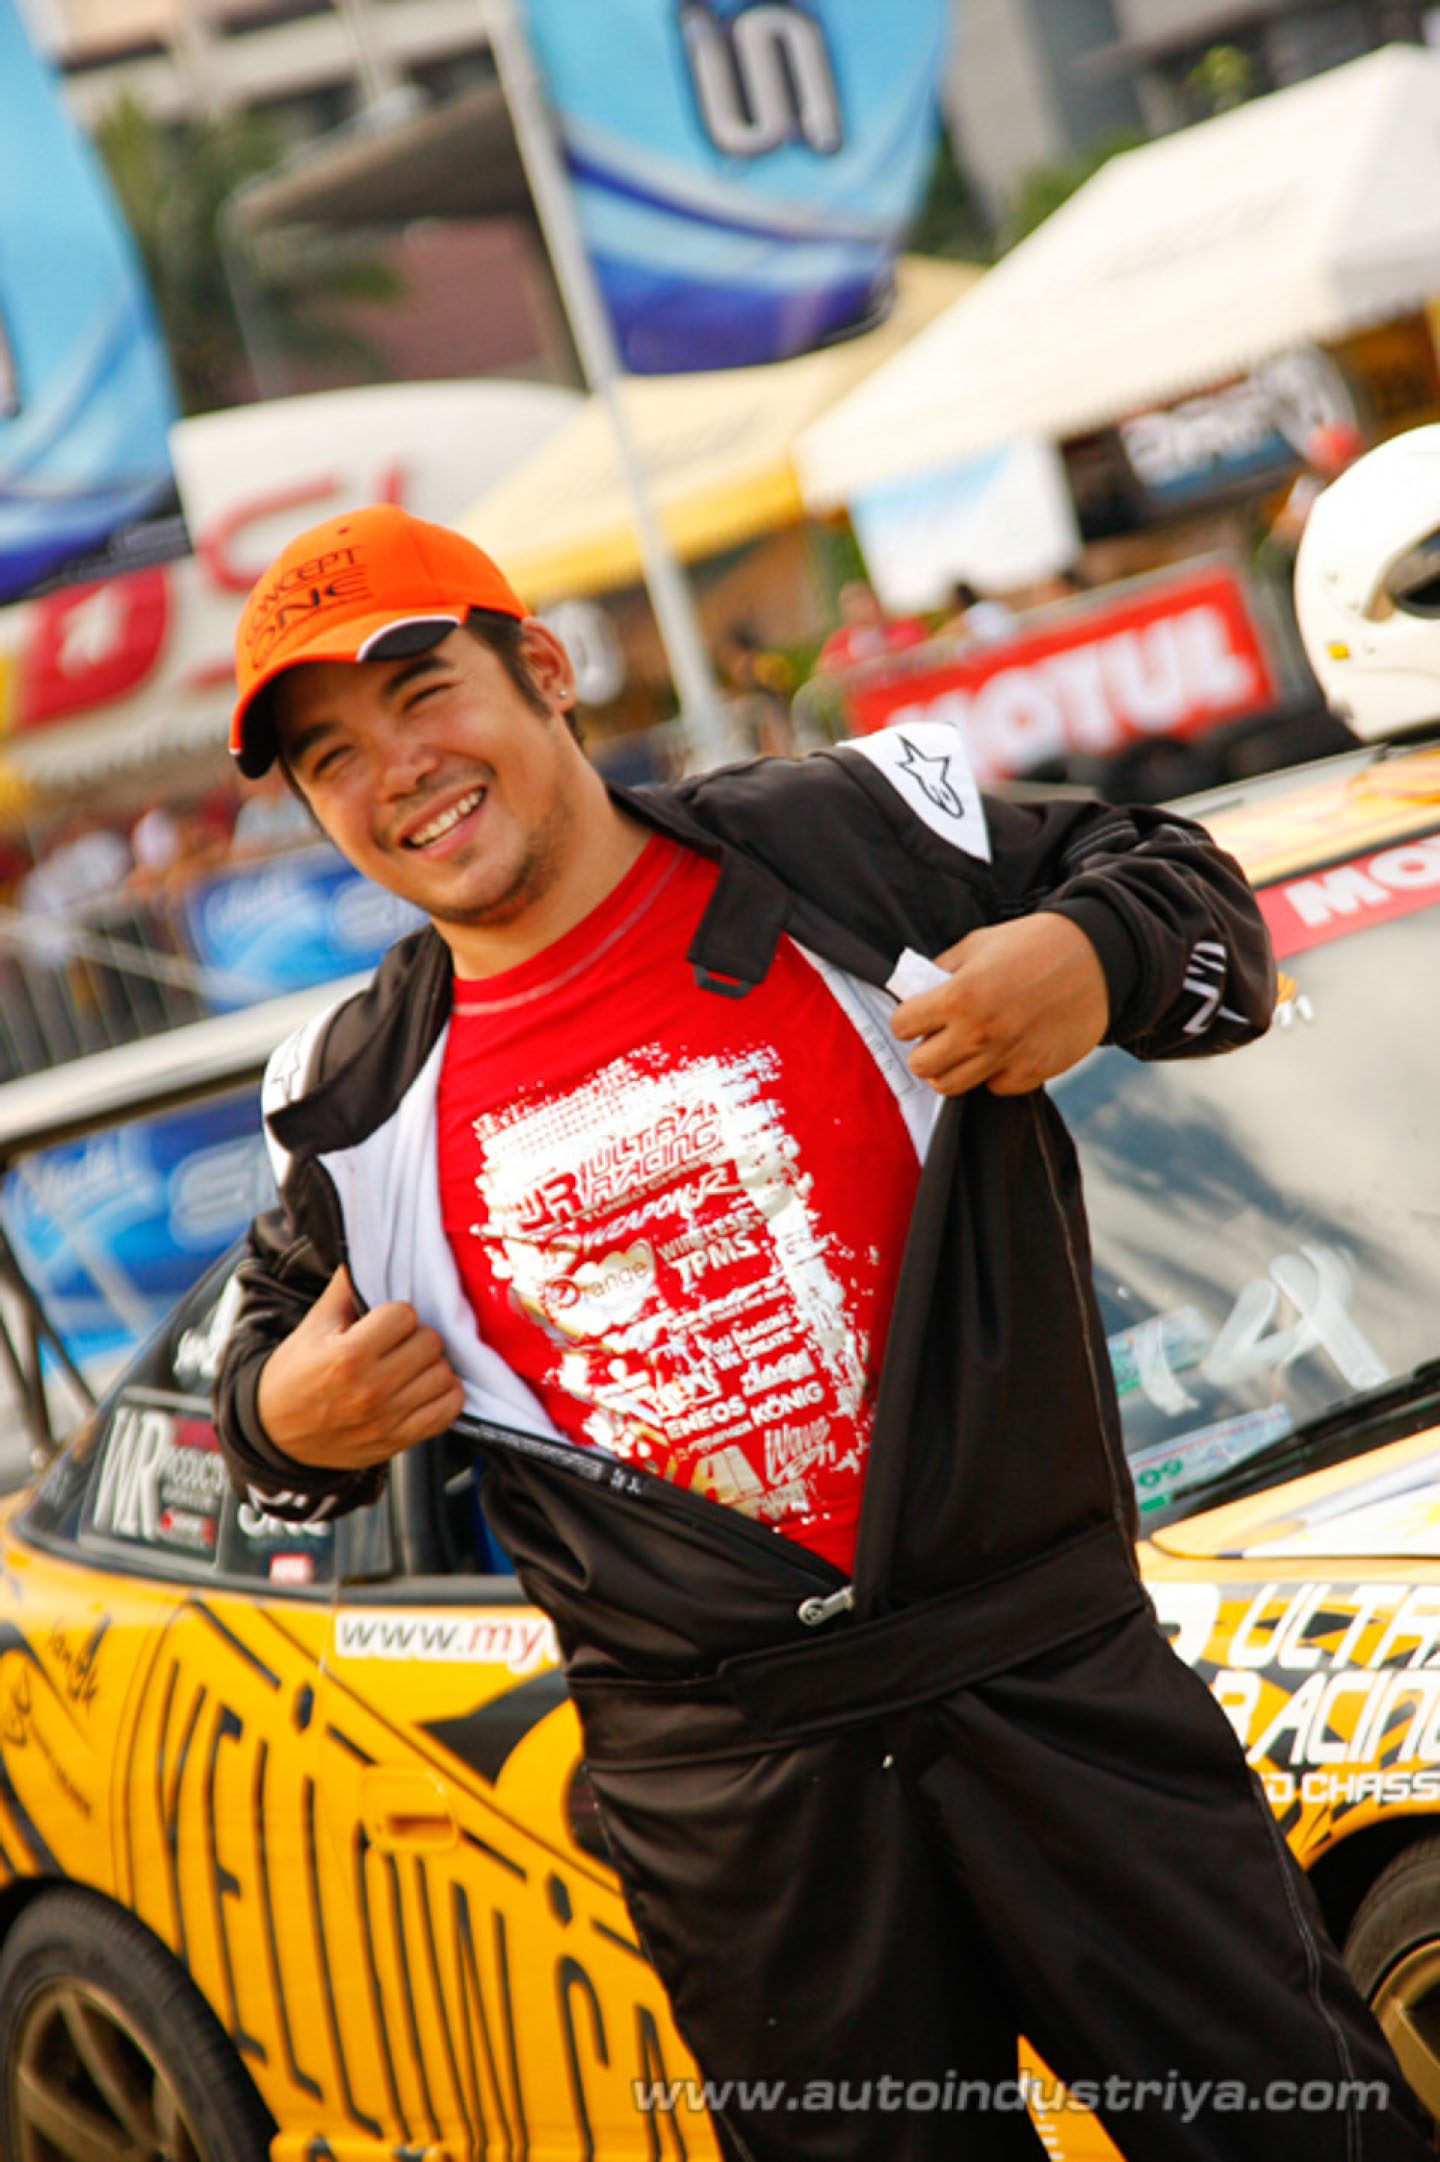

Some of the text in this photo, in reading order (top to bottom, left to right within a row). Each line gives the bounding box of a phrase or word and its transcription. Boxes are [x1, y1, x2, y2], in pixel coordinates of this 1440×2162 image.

[1283, 834, 1440, 929] MO
[671, 1228, 761, 1292] TPMS
[663, 1395, 747, 1439] ENEOS
[751, 1380, 825, 1428] KÖNIG
[342, 1620, 547, 1666] www.my
[1226, 1583, 1440, 1669] ULTR
